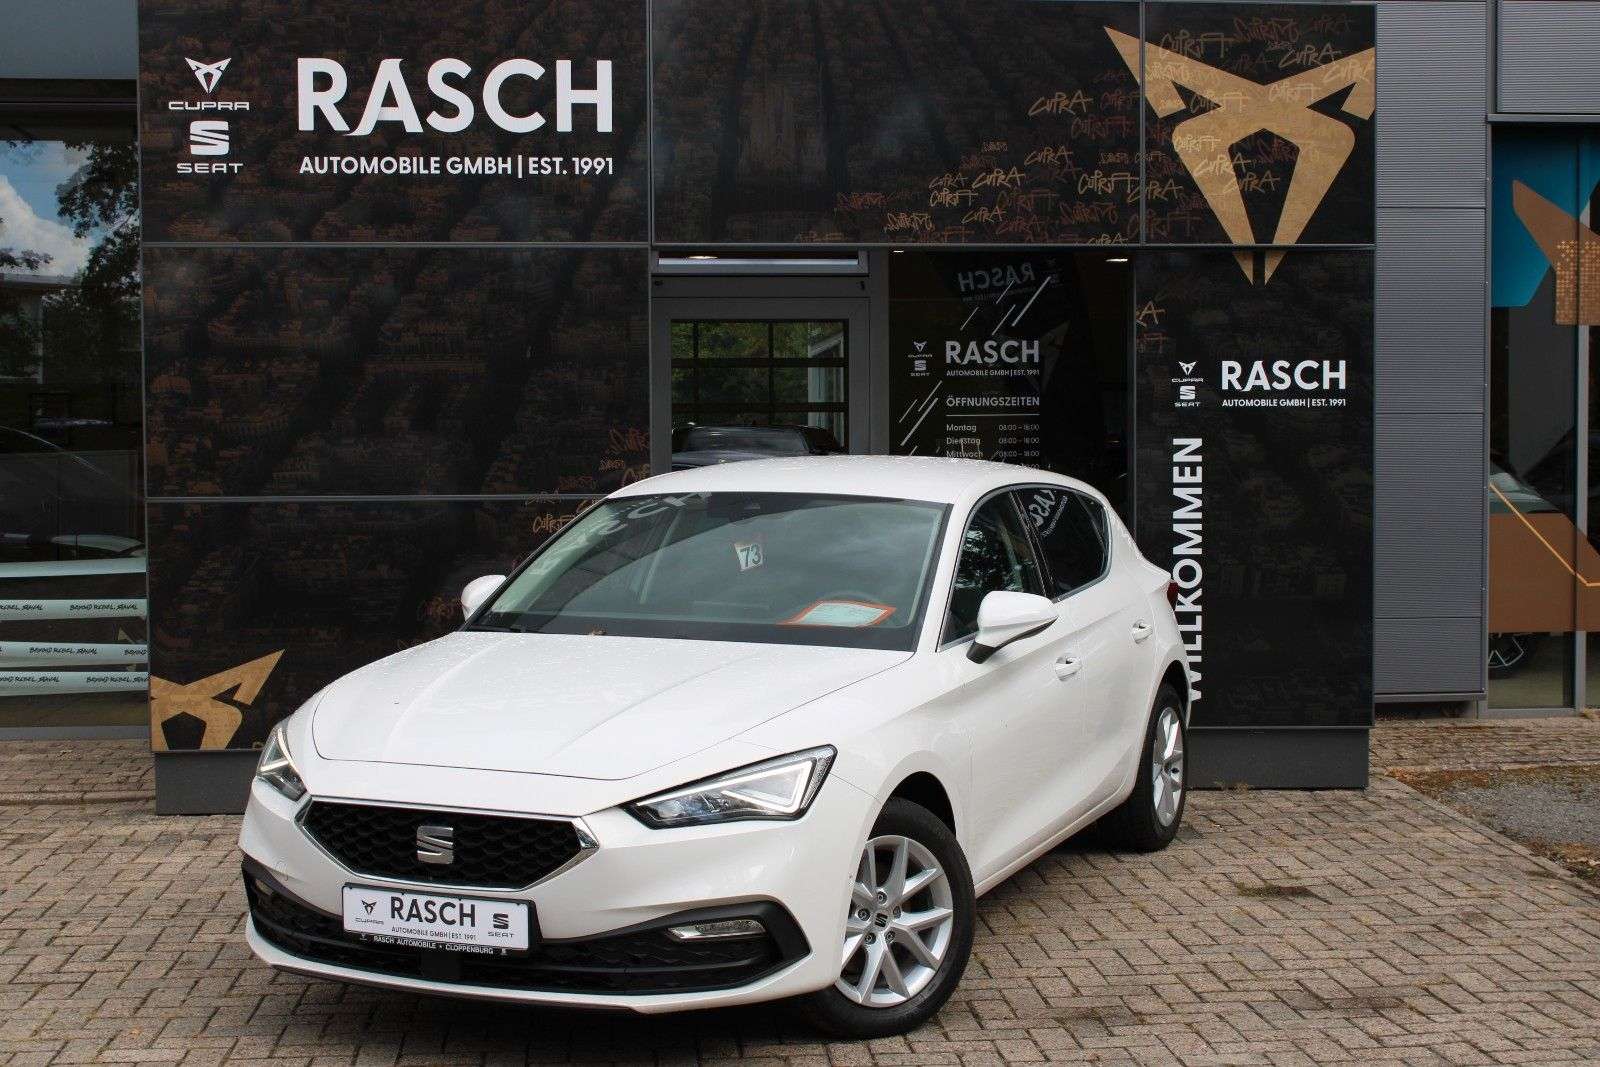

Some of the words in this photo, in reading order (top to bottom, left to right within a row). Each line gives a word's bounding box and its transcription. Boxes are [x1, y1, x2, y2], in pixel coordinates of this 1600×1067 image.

[297, 57, 613, 137] RASCH
[168, 101, 250, 111] CUPRA
[176, 162, 244, 174] SEAT
[299, 156, 441, 175] AUTOMOBILE
[446, 156, 512, 175] GMBH
[528, 157, 568, 175] EST.
[572, 157, 613, 175] 1991
[945, 340, 1040, 365] RASCH
[989, 369, 1009, 377] GMBH
[1221, 360, 1346, 392] RASCH
[946, 395, 1040, 407] ÖFFNUNGSZEITEN
[1222, 399, 1278, 407] AUTOMOBILE
[1280, 399, 1306, 407] GMBH
[1311, 399, 1328, 407] EST.
[1329, 399, 1346, 407] 1991
[946, 424, 977, 432] Montag
[946, 437, 981, 445] Dienstag
[739, 543, 763, 568] 73
[390, 896, 476, 927] RASCH
[354, 917, 385, 925] CUPRA
[391, 926, 429, 936] AUTOMOBILE
[429, 930, 448, 938] GMBH
[487, 931, 516, 939] SEAT
[373, 935, 395, 944] RASCH
[397, 938, 436, 949] AUTOMOBILE
[445, 943, 494, 955] CLOPPENBURG
